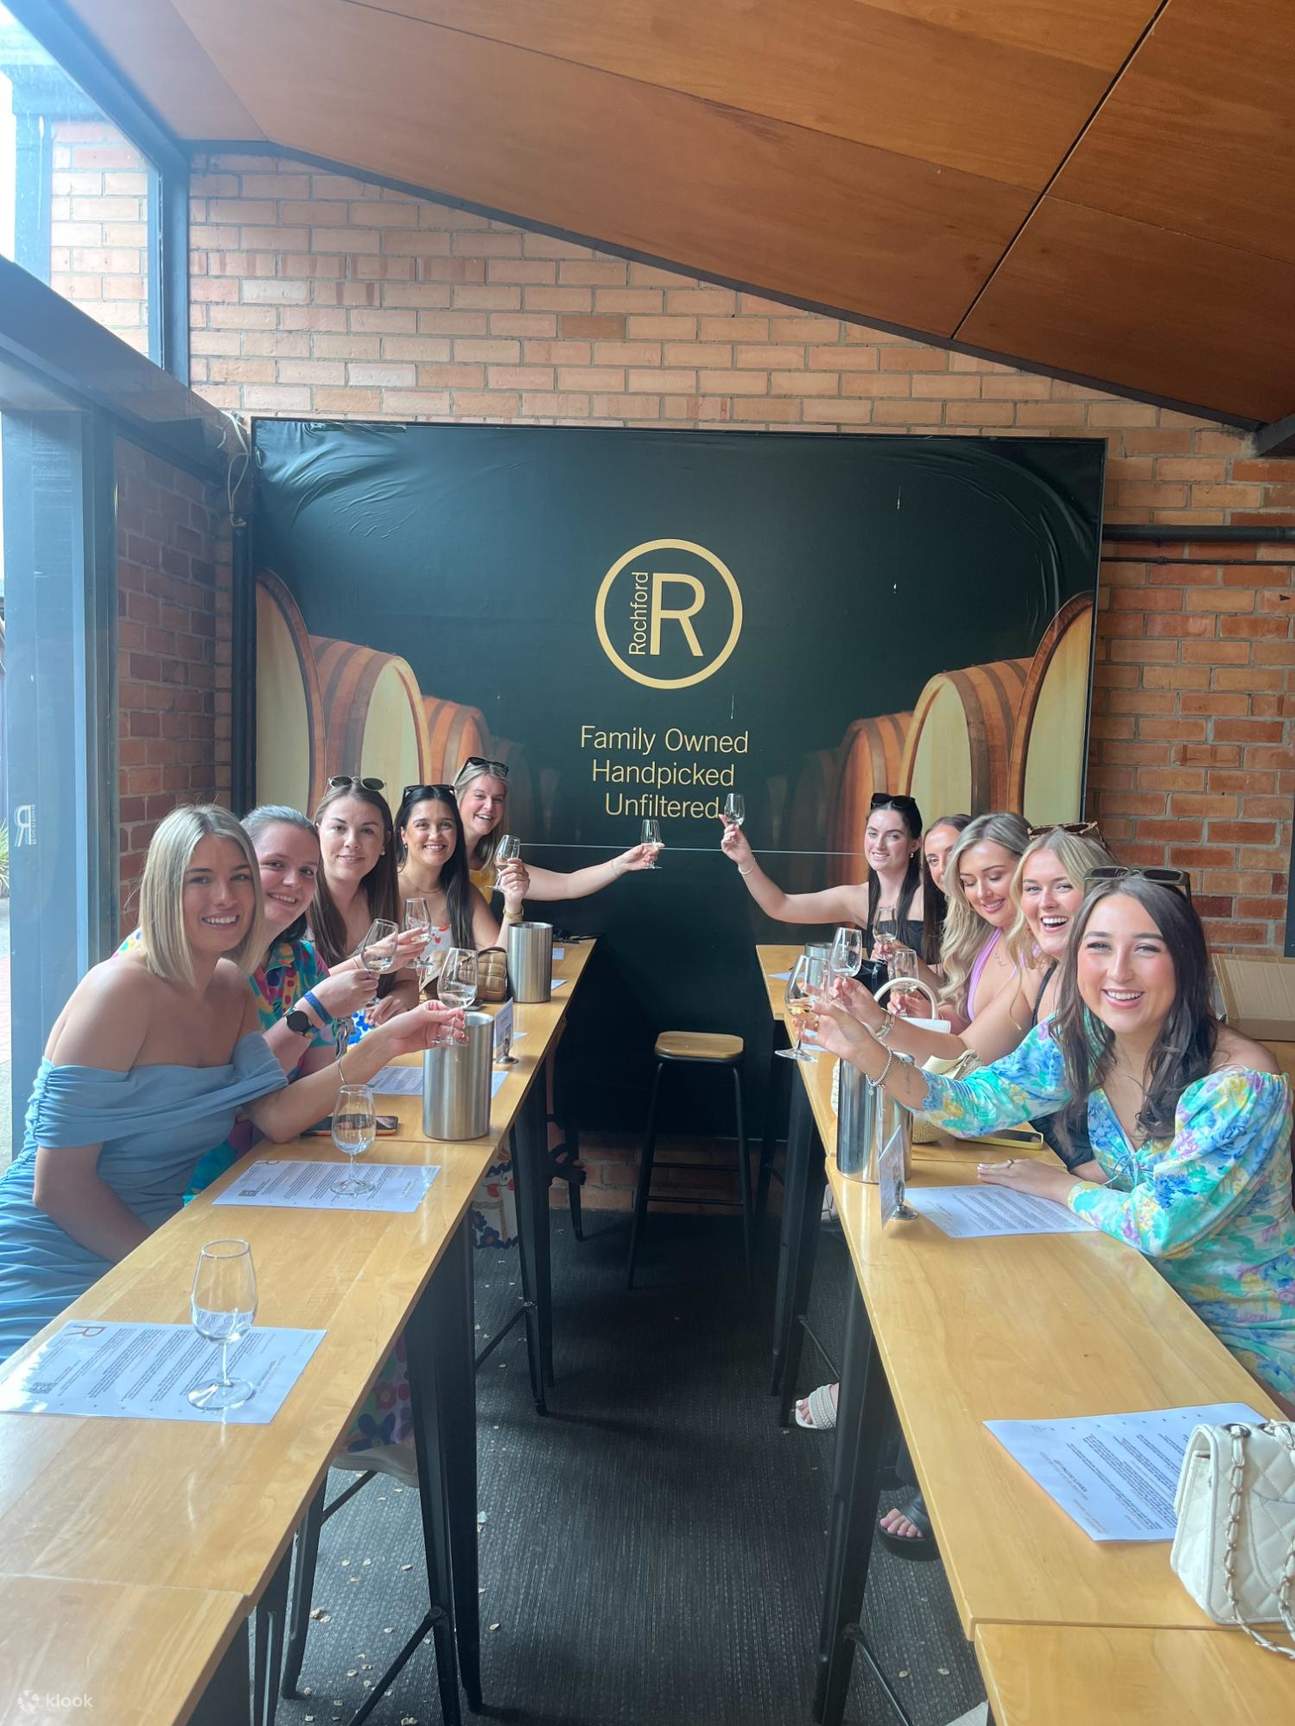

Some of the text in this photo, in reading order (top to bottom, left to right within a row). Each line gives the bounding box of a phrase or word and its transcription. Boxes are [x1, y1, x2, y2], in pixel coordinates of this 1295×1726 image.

[629, 571, 649, 656] Rochford
[650, 572, 705, 656] R
[581, 725, 749, 755] Family Owned
[593, 760, 734, 788] Handpicked
[605, 792, 720, 819] Unfiltered
